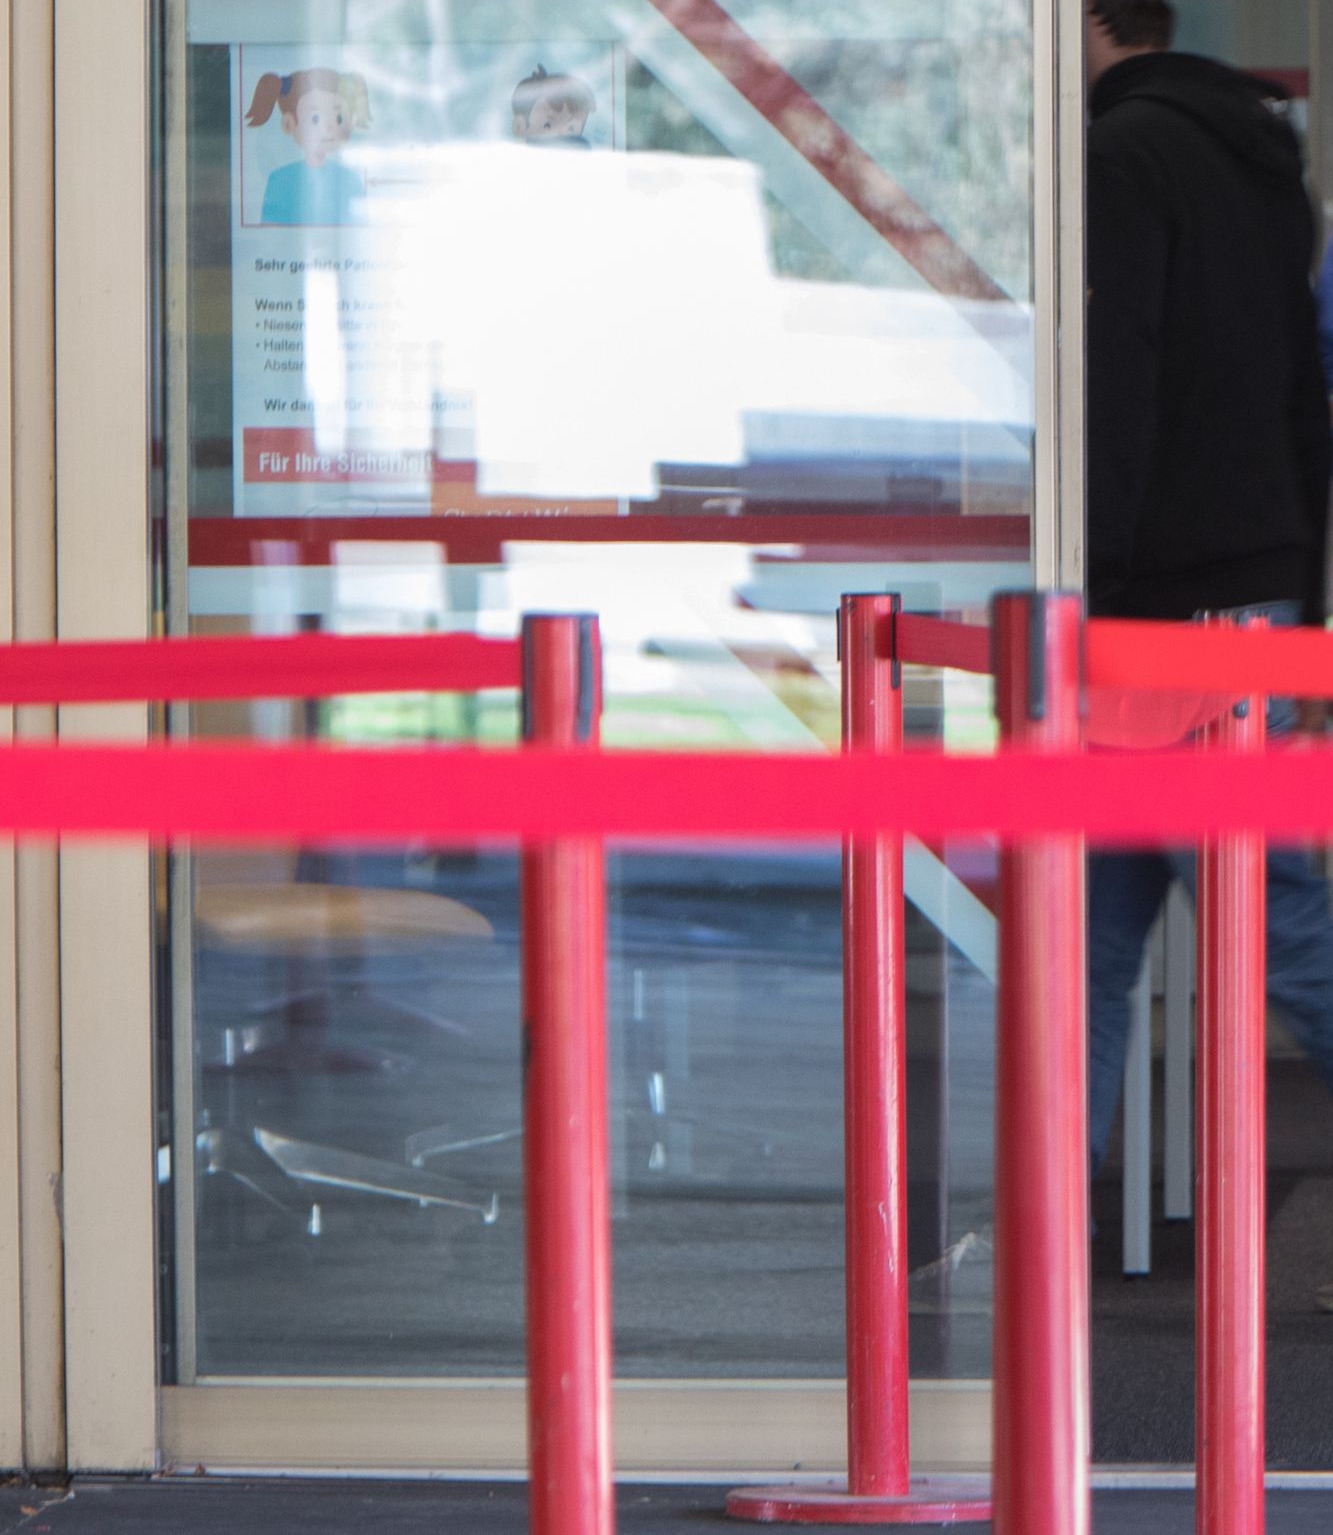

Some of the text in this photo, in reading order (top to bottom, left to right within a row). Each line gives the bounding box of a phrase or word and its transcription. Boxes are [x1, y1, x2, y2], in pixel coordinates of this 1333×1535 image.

[254, 257, 286, 272] Sehr
[254, 297, 293, 311] Wenn
[263, 396, 288, 412] Wir
[259, 451, 434, 476] Für Ihre Sicherheit
